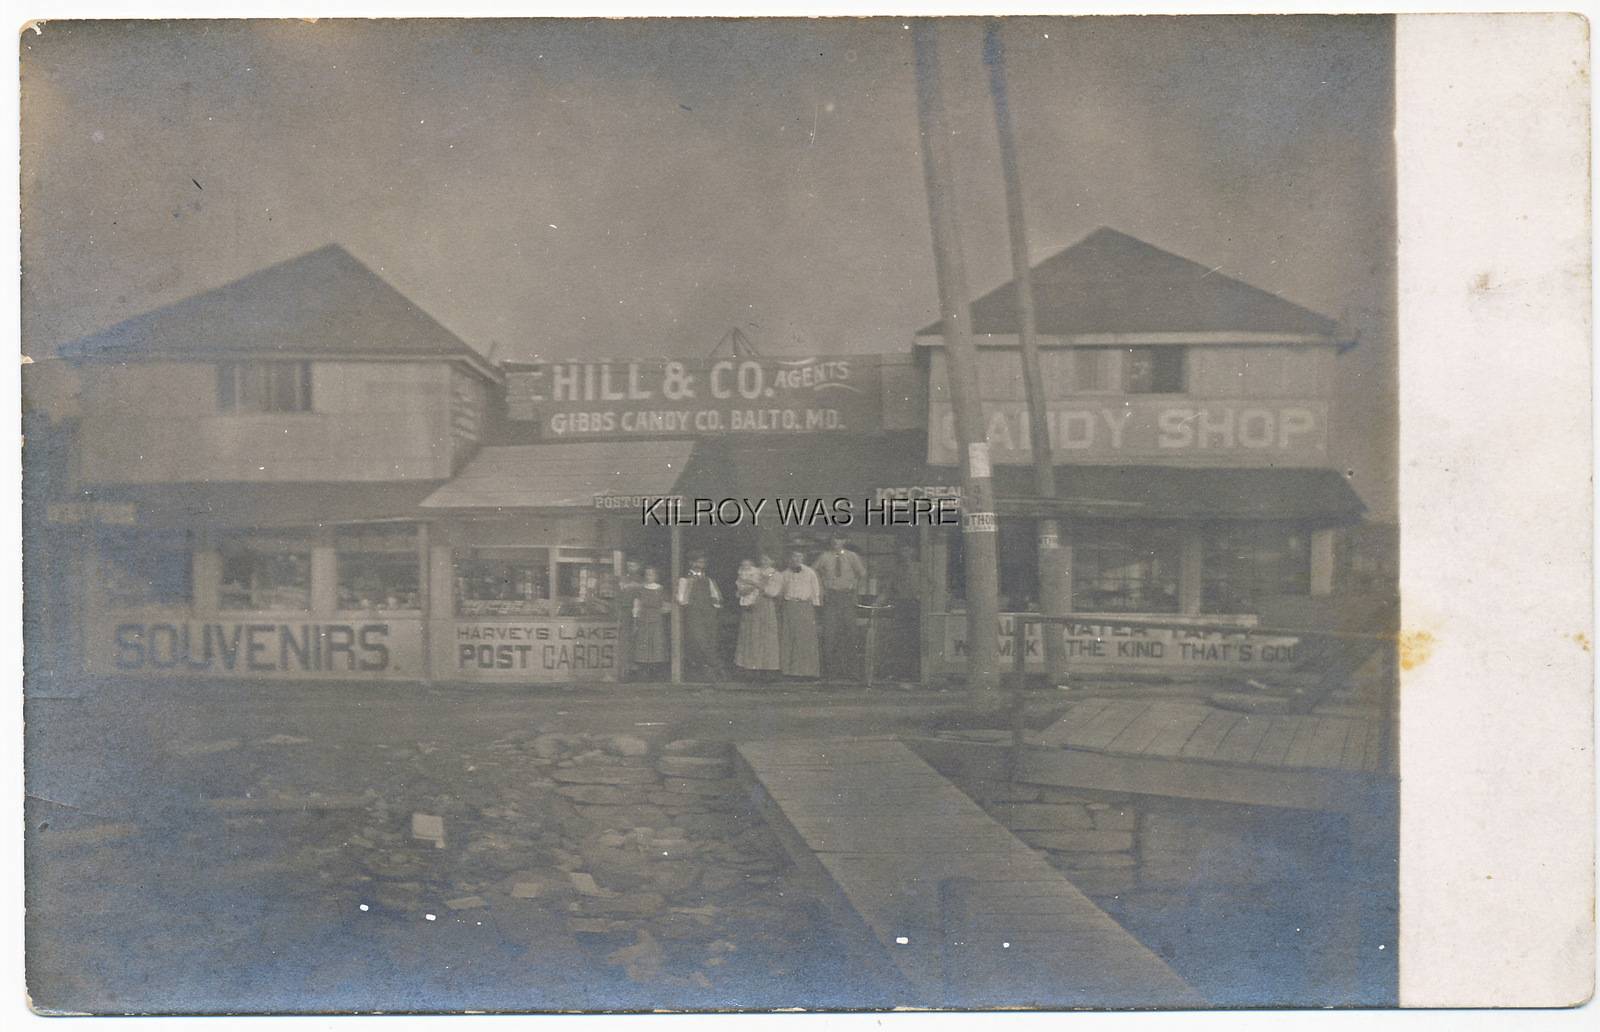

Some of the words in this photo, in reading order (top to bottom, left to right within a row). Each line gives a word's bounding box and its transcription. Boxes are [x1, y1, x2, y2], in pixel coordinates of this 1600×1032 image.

[553, 364, 651, 401] HILL
[662, 361, 695, 400] &
[709, 360, 775, 400] CO.
[774, 361, 849, 389] AGENTS
[550, 411, 615, 434] GIBBS
[620, 411, 690, 432] CANDY
[695, 410, 725, 431] CO.
[595, 496, 631, 509] POST
[907, 485, 961, 502] CREA
[457, 627, 549, 640] HARVEYS
[559, 626, 617, 640] LAKE
[458, 644, 532, 669] POST
[542, 644, 614, 669] CARDS
[1066, 639, 1106, 657] THE
[1117, 640, 1164, 659] KIND
[1179, 642, 1252, 661] THAT'S
